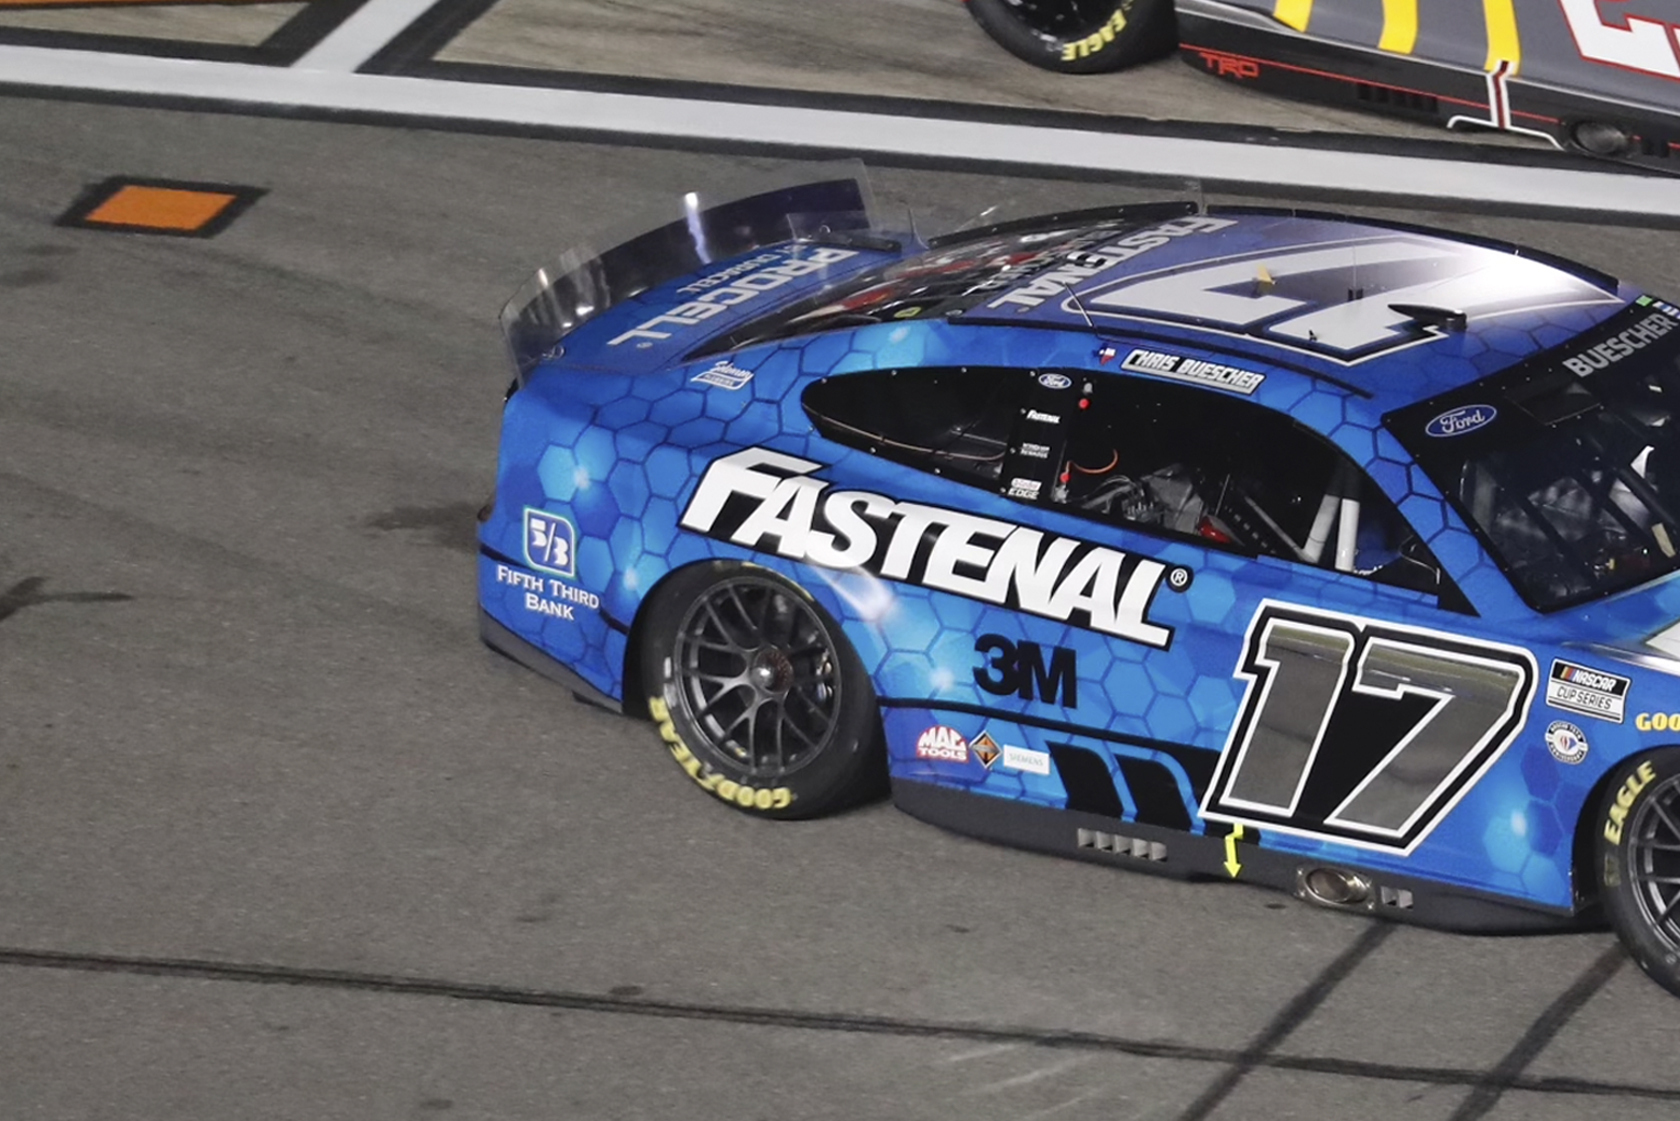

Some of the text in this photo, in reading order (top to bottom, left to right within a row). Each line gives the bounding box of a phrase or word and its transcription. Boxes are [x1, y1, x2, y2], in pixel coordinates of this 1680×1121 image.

[1060, 8, 1127, 62] EAGLE
[606, 247, 859, 347] PROCELL
[1129, 349, 1266, 389] CHRIS BUESCHER
[1562, 312, 1678, 379] BUESCHER
[680, 447, 1173, 648] FASTENAL
[496, 564, 601, 610] FIFTH THIRD
[525, 593, 575, 621] BANK
[972, 633, 1078, 709] 3M
[1557, 685, 1613, 710] CUP SERIES
[1571, 669, 1617, 692] NASCAR
[647, 695, 792, 810] GOODYEAR
[918, 725, 967, 751] MAC
[919, 748, 967, 760] TOOLS
[1198, 598, 1540, 857] 17
[1603, 760, 1658, 847] EAGLE
